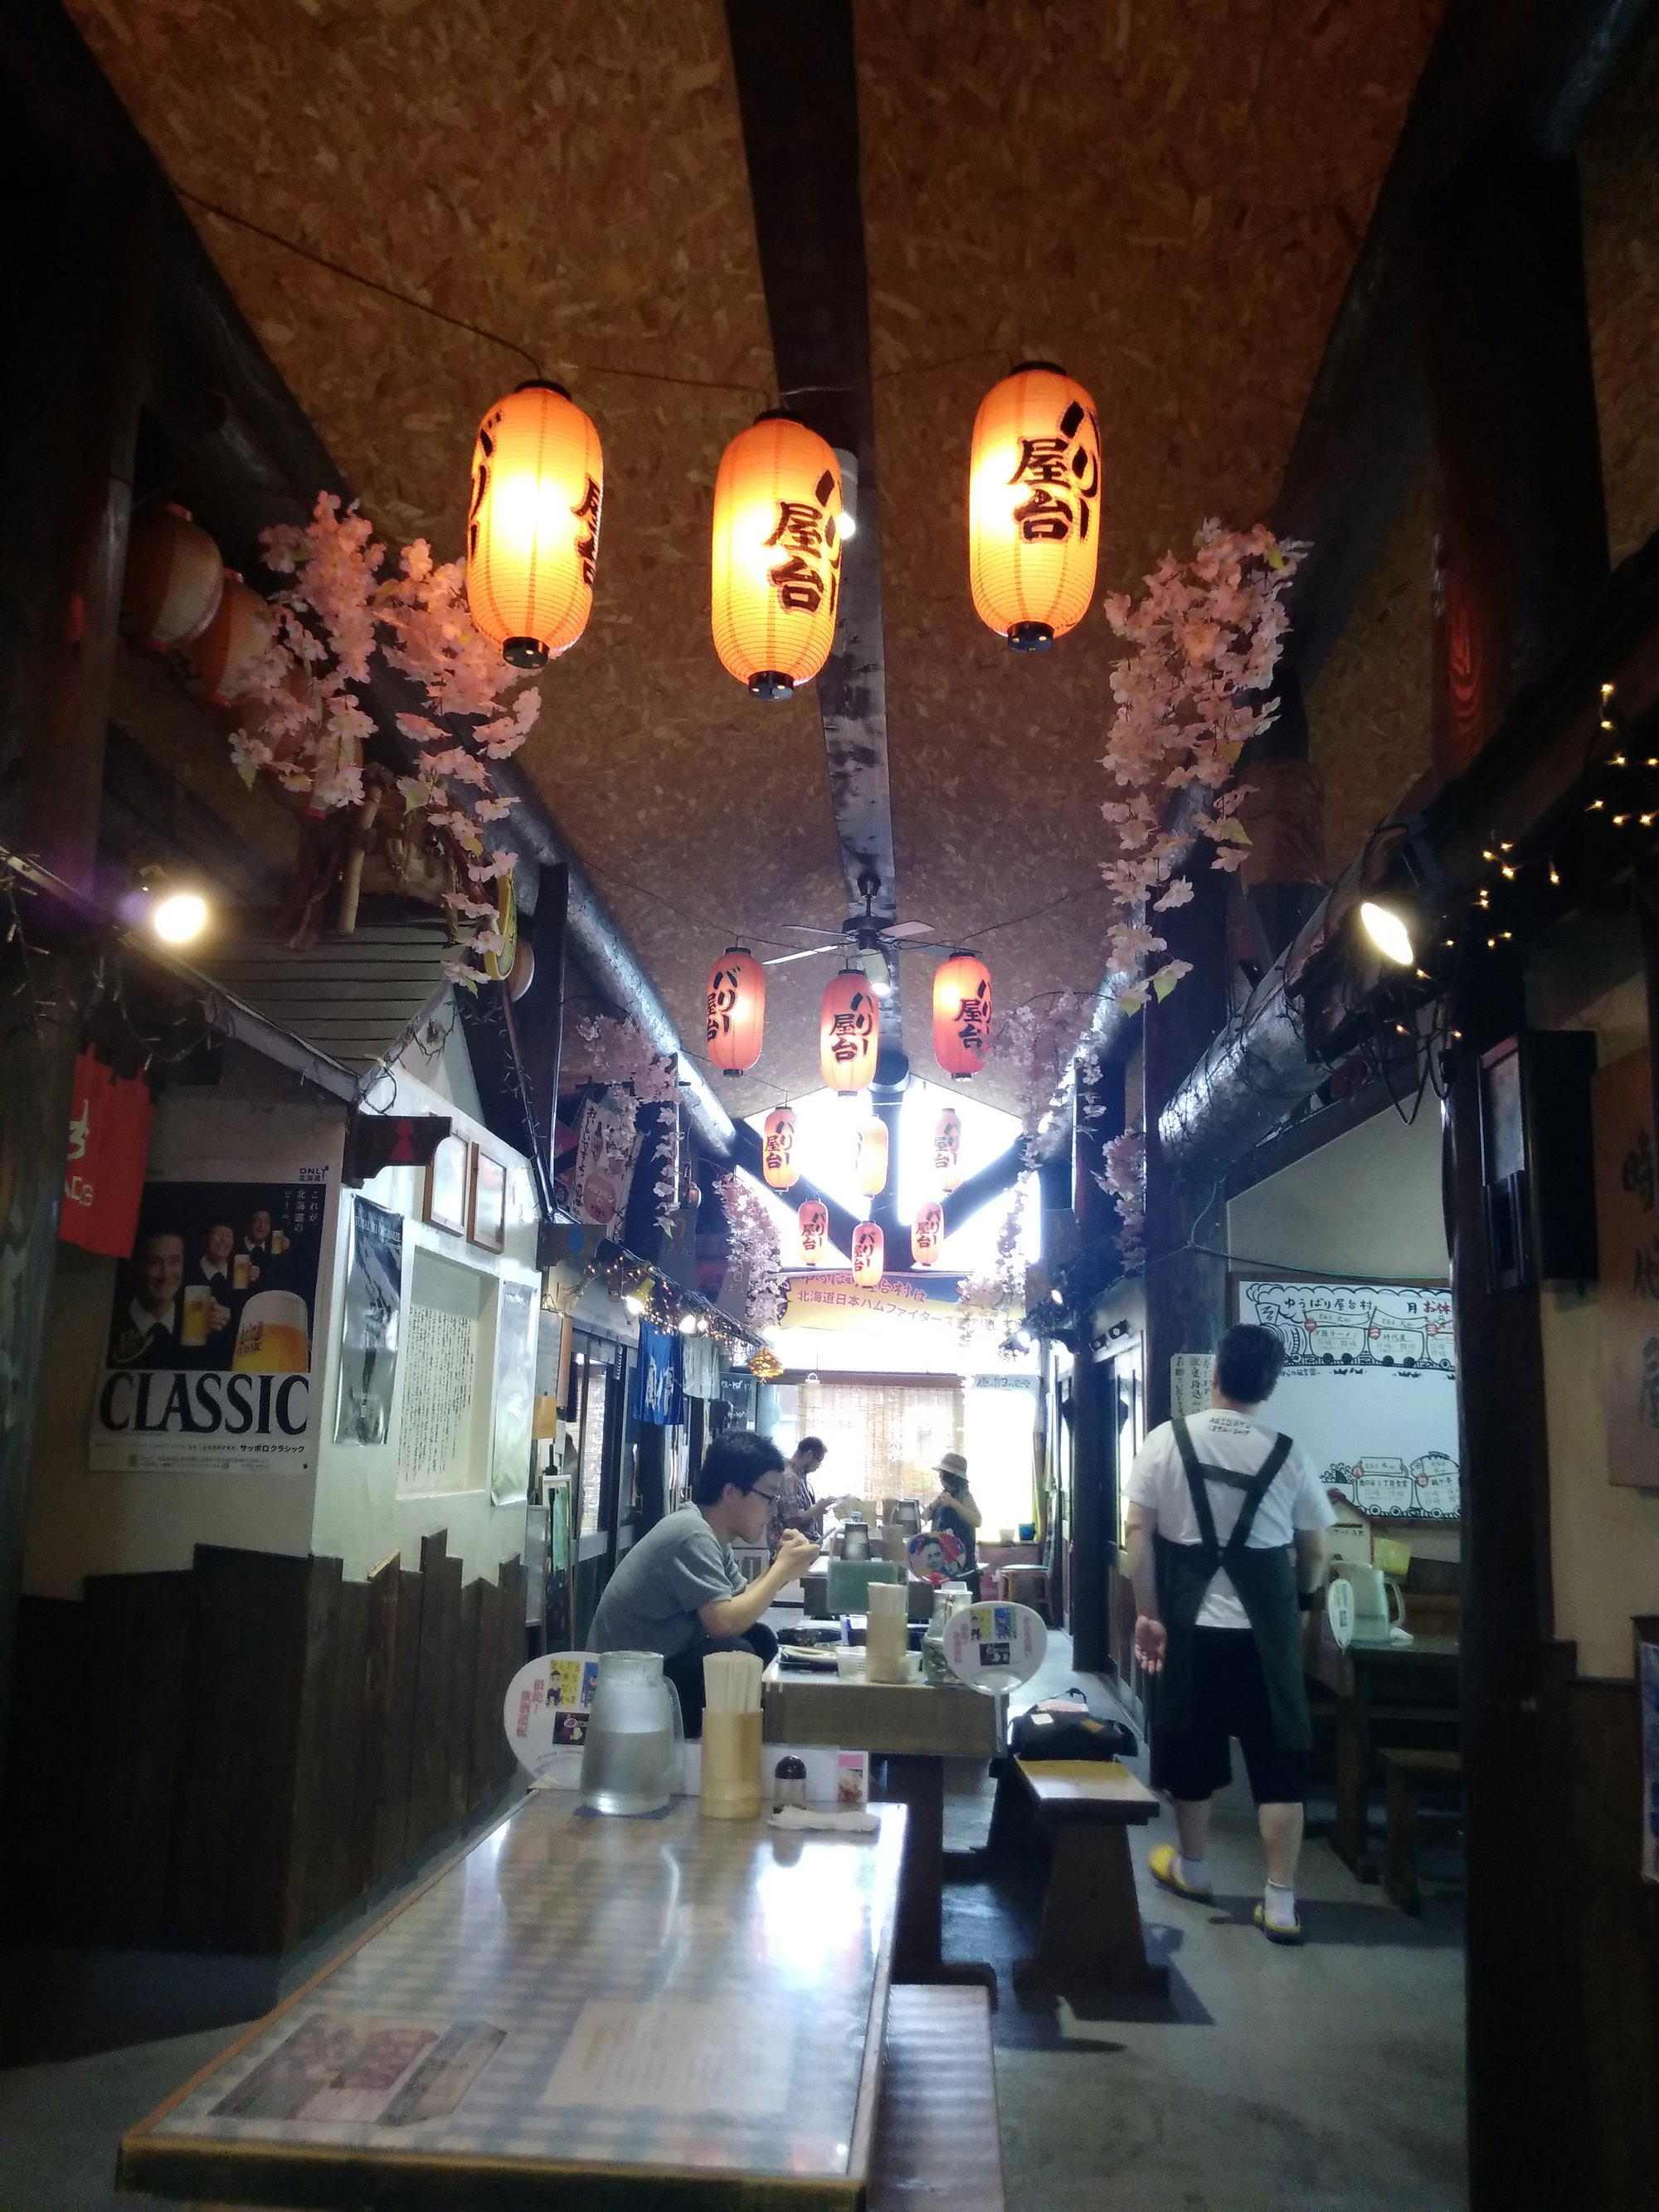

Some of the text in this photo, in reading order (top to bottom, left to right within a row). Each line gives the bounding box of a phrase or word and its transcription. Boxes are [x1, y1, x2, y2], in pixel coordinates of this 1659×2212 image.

[1007, 437, 1074, 541] 屋台
[765, 500, 825, 613] 屋台
[829, 1012, 859, 1063] 屋台
[764, 1134, 783, 1171] 屋台
[801, 1223, 817, 1251] 屋台
[915, 1221, 932, 1249] 屋台
[1407, 1302, 1418, 1314] 月
[99, 1370, 310, 1435] CLASSIC
